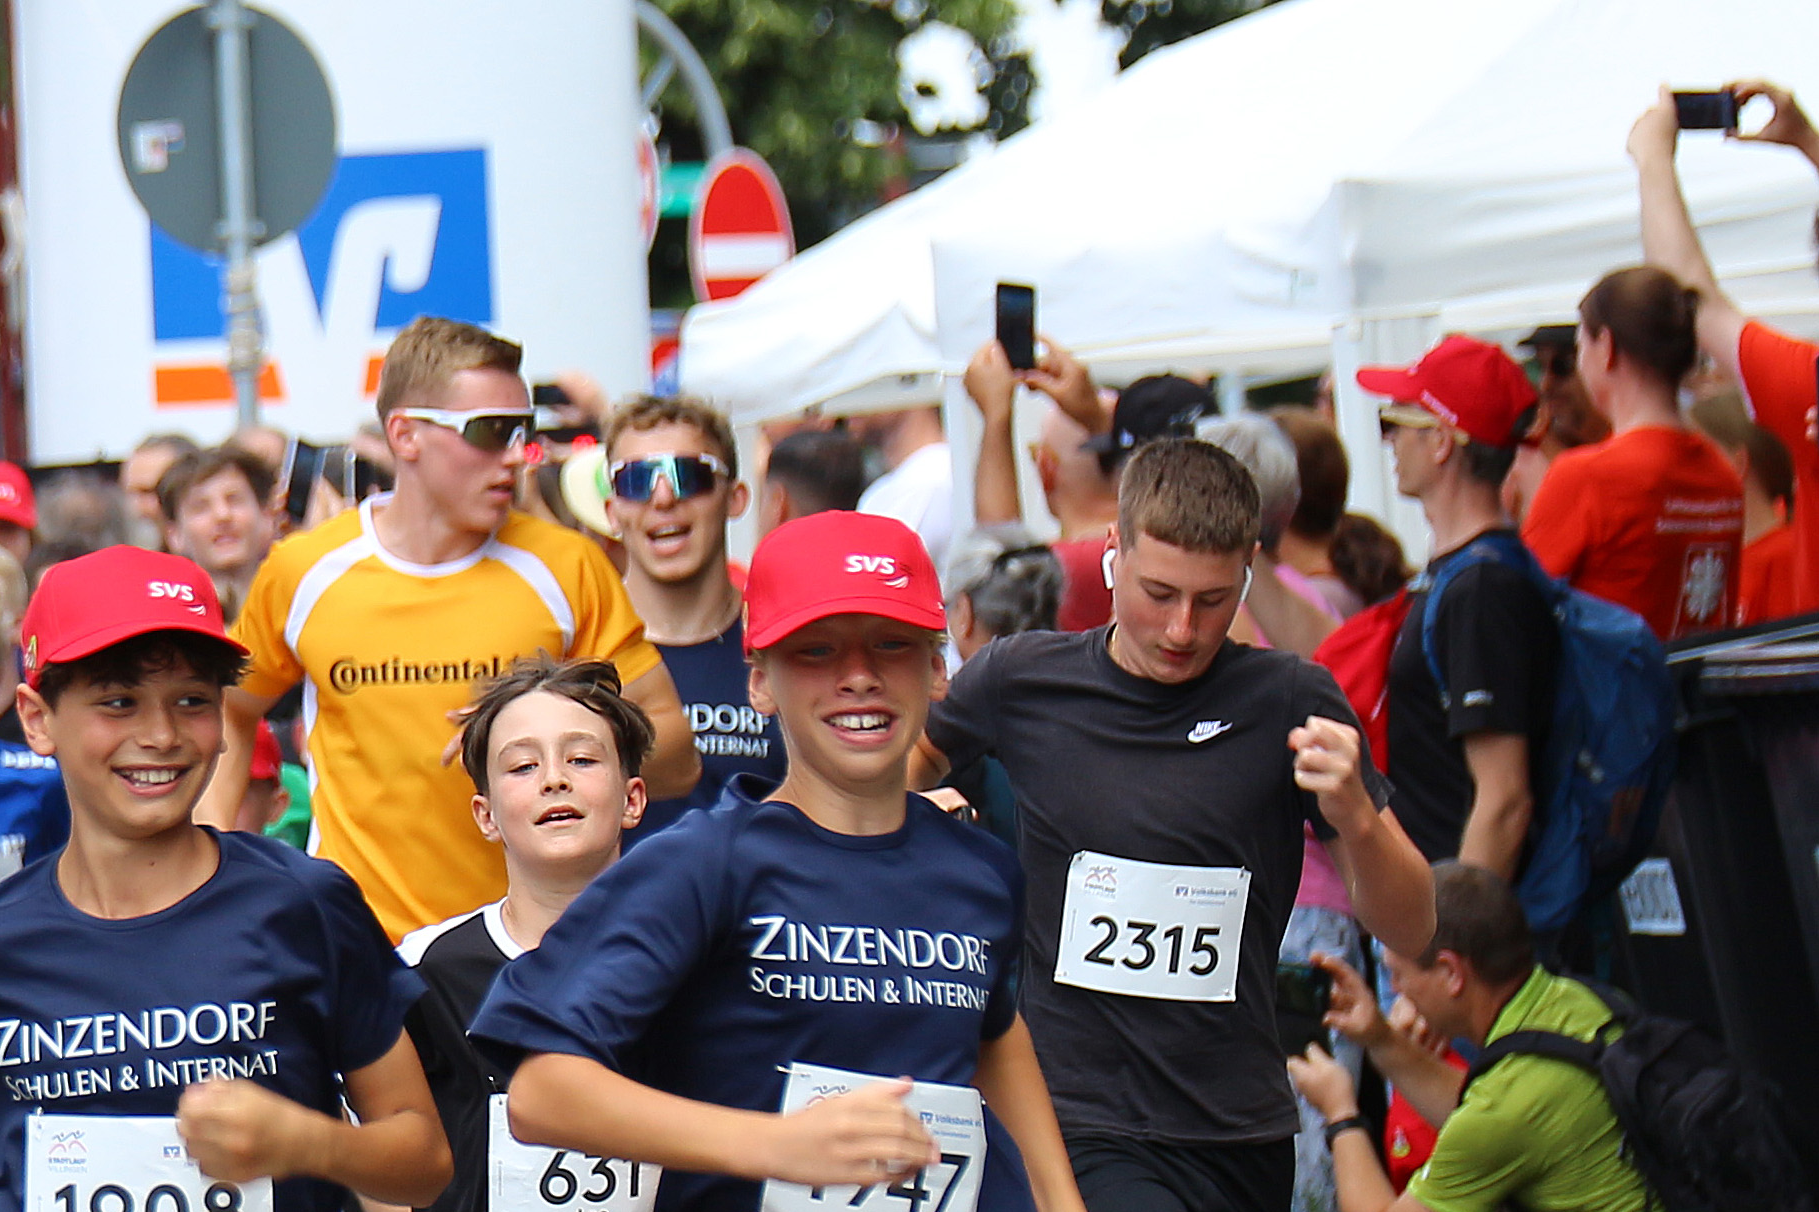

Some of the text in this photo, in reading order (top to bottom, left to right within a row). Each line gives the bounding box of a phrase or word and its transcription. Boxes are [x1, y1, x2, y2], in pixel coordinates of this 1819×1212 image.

[845, 555, 896, 575] SVS
[148, 582, 195, 602] SVS
[330, 655, 500, 695] Continental
[693, 734, 771, 758] NTERNAT
[749, 915, 992, 976] ZINZENDORF
[1084, 914, 1222, 977] 2315
[750, 967, 877, 1004] SCHULEN
[883, 979, 901, 1005] &
[5, 1049, 279, 1101] SCHULEN & INTERNAT
[538, 1151, 640, 1205] 631
